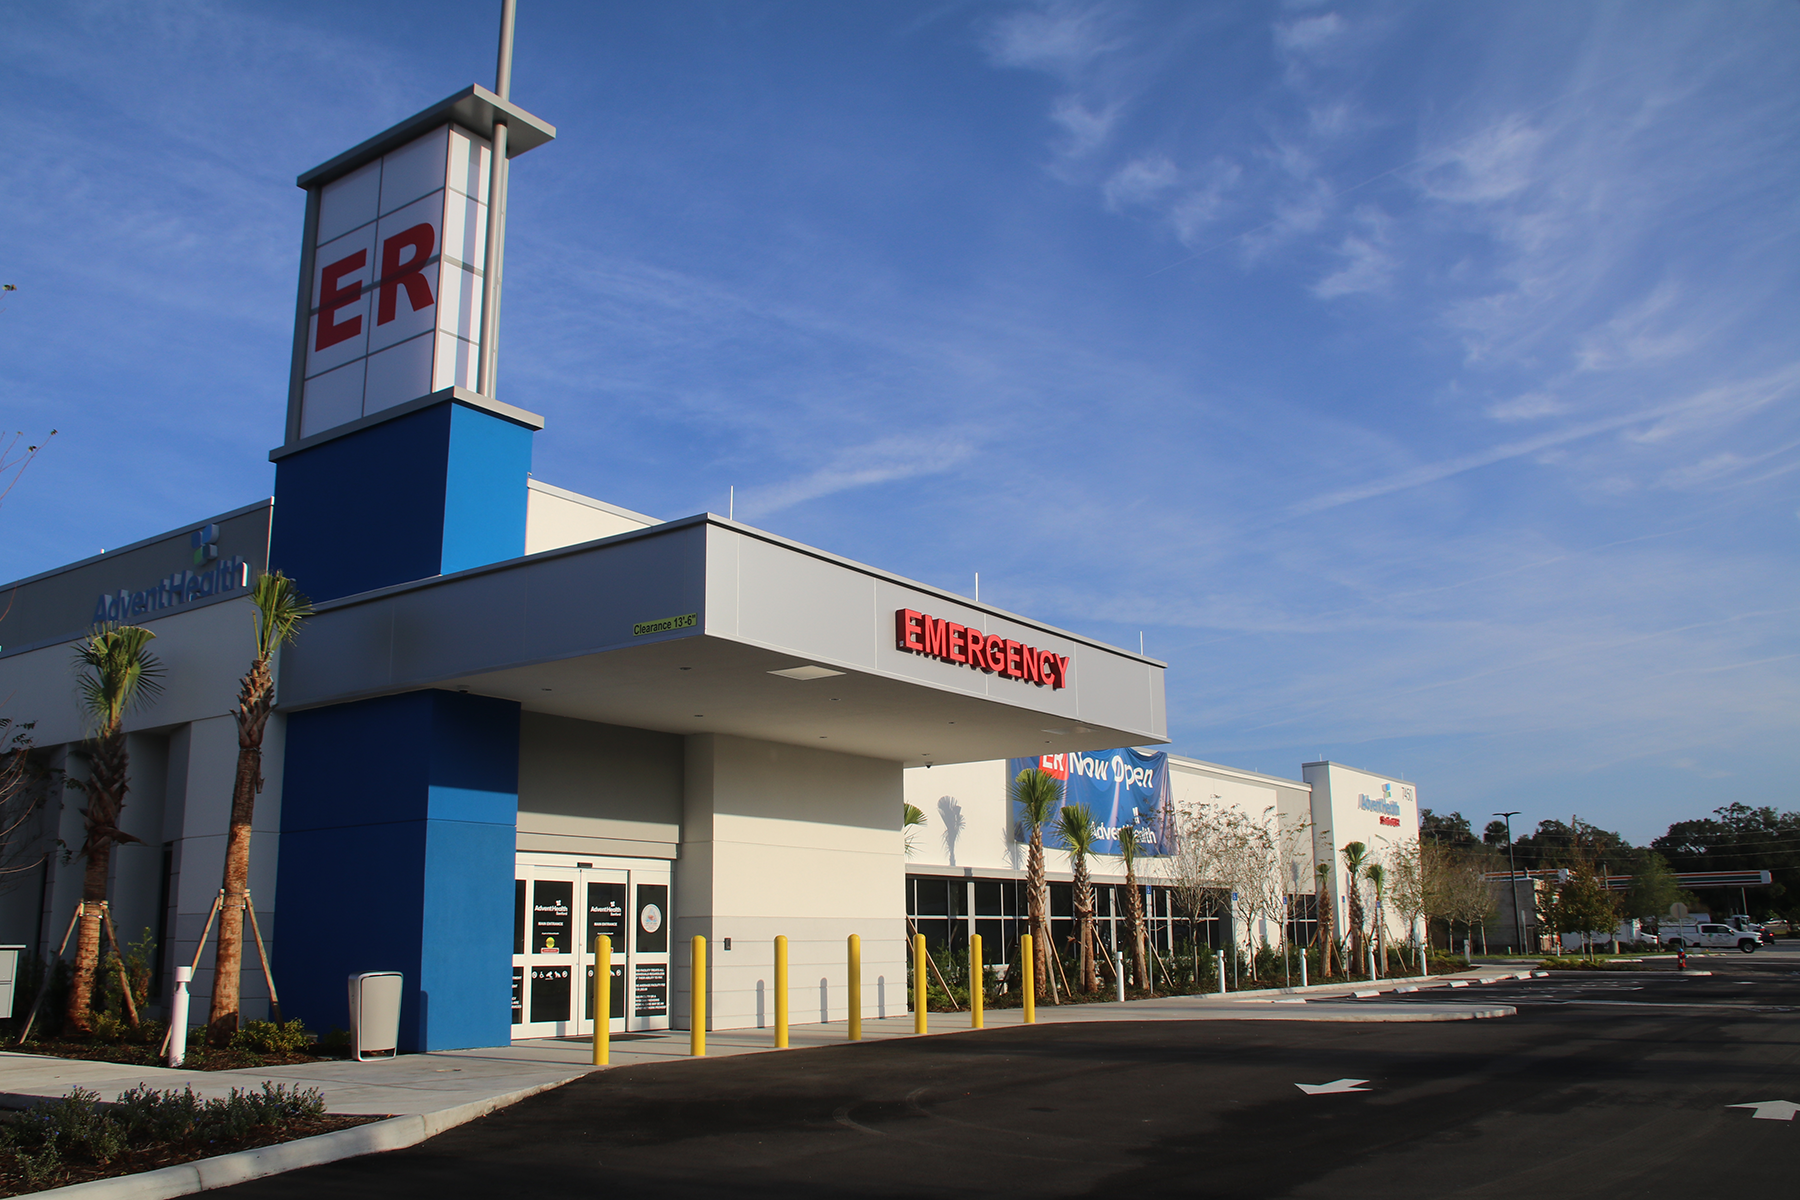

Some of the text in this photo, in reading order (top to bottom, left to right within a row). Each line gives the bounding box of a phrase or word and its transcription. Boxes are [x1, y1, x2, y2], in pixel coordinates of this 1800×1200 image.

[315, 222, 435, 352] ER
[92, 555, 252, 627] AdventHealth
[634, 620, 672, 635] Clearance
[896, 608, 1070, 690] EMERGENCY
[1042, 751, 1154, 791] ER Now Open
